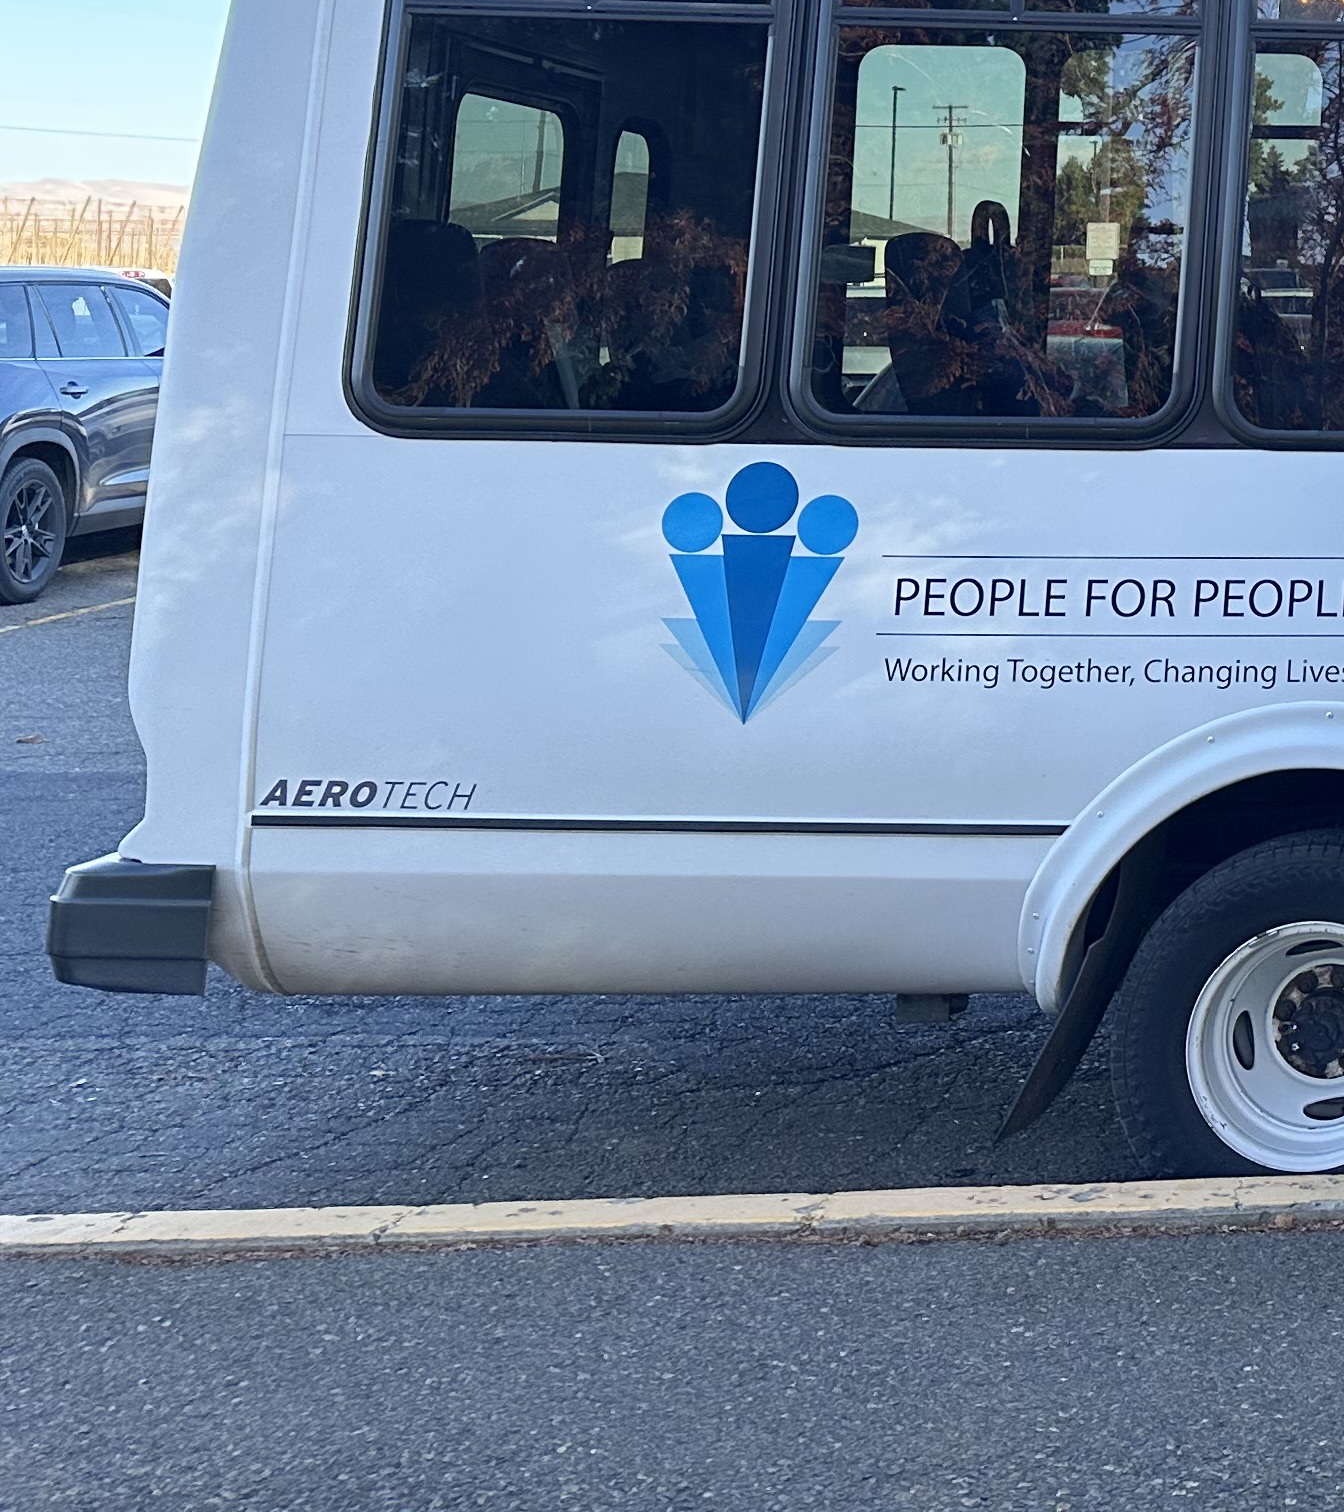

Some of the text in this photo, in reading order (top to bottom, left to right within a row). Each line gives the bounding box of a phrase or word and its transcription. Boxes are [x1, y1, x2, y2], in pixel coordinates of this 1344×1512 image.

[894, 578, 1068, 617] PEOPLE
[1085, 579, 1176, 618] FOR
[885, 658, 999, 688] Working
[1007, 658, 1135, 688] Together,
[1145, 658, 1278, 689] Changing
[259, 779, 478, 810] AEROTECH
